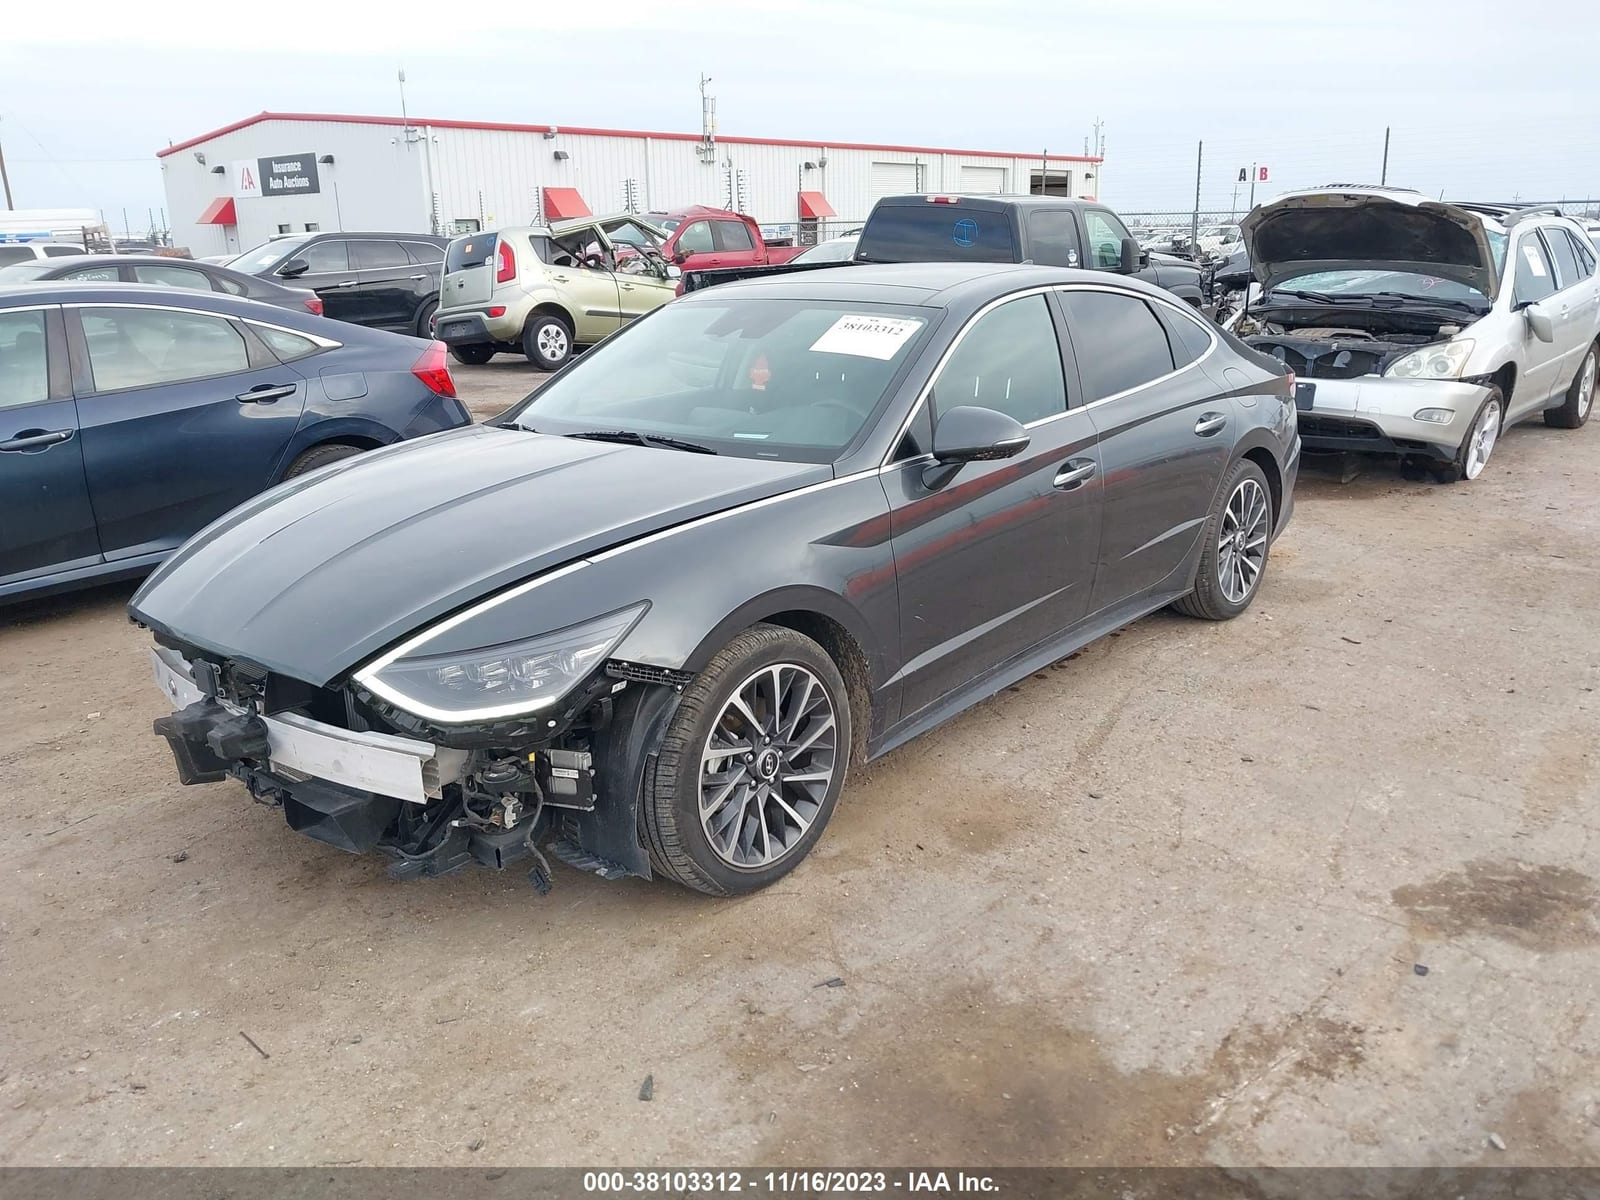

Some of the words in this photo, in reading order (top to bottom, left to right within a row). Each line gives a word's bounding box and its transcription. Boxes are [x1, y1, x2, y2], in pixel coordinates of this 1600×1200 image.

[272, 161, 301, 173] Insurance
[1260, 167, 1268, 180] B
[1238, 168, 1247, 181] A
[270, 177, 283, 189] Auto
[284, 175, 309, 188] Auctions
[838, 322, 904, 336] 38103312
